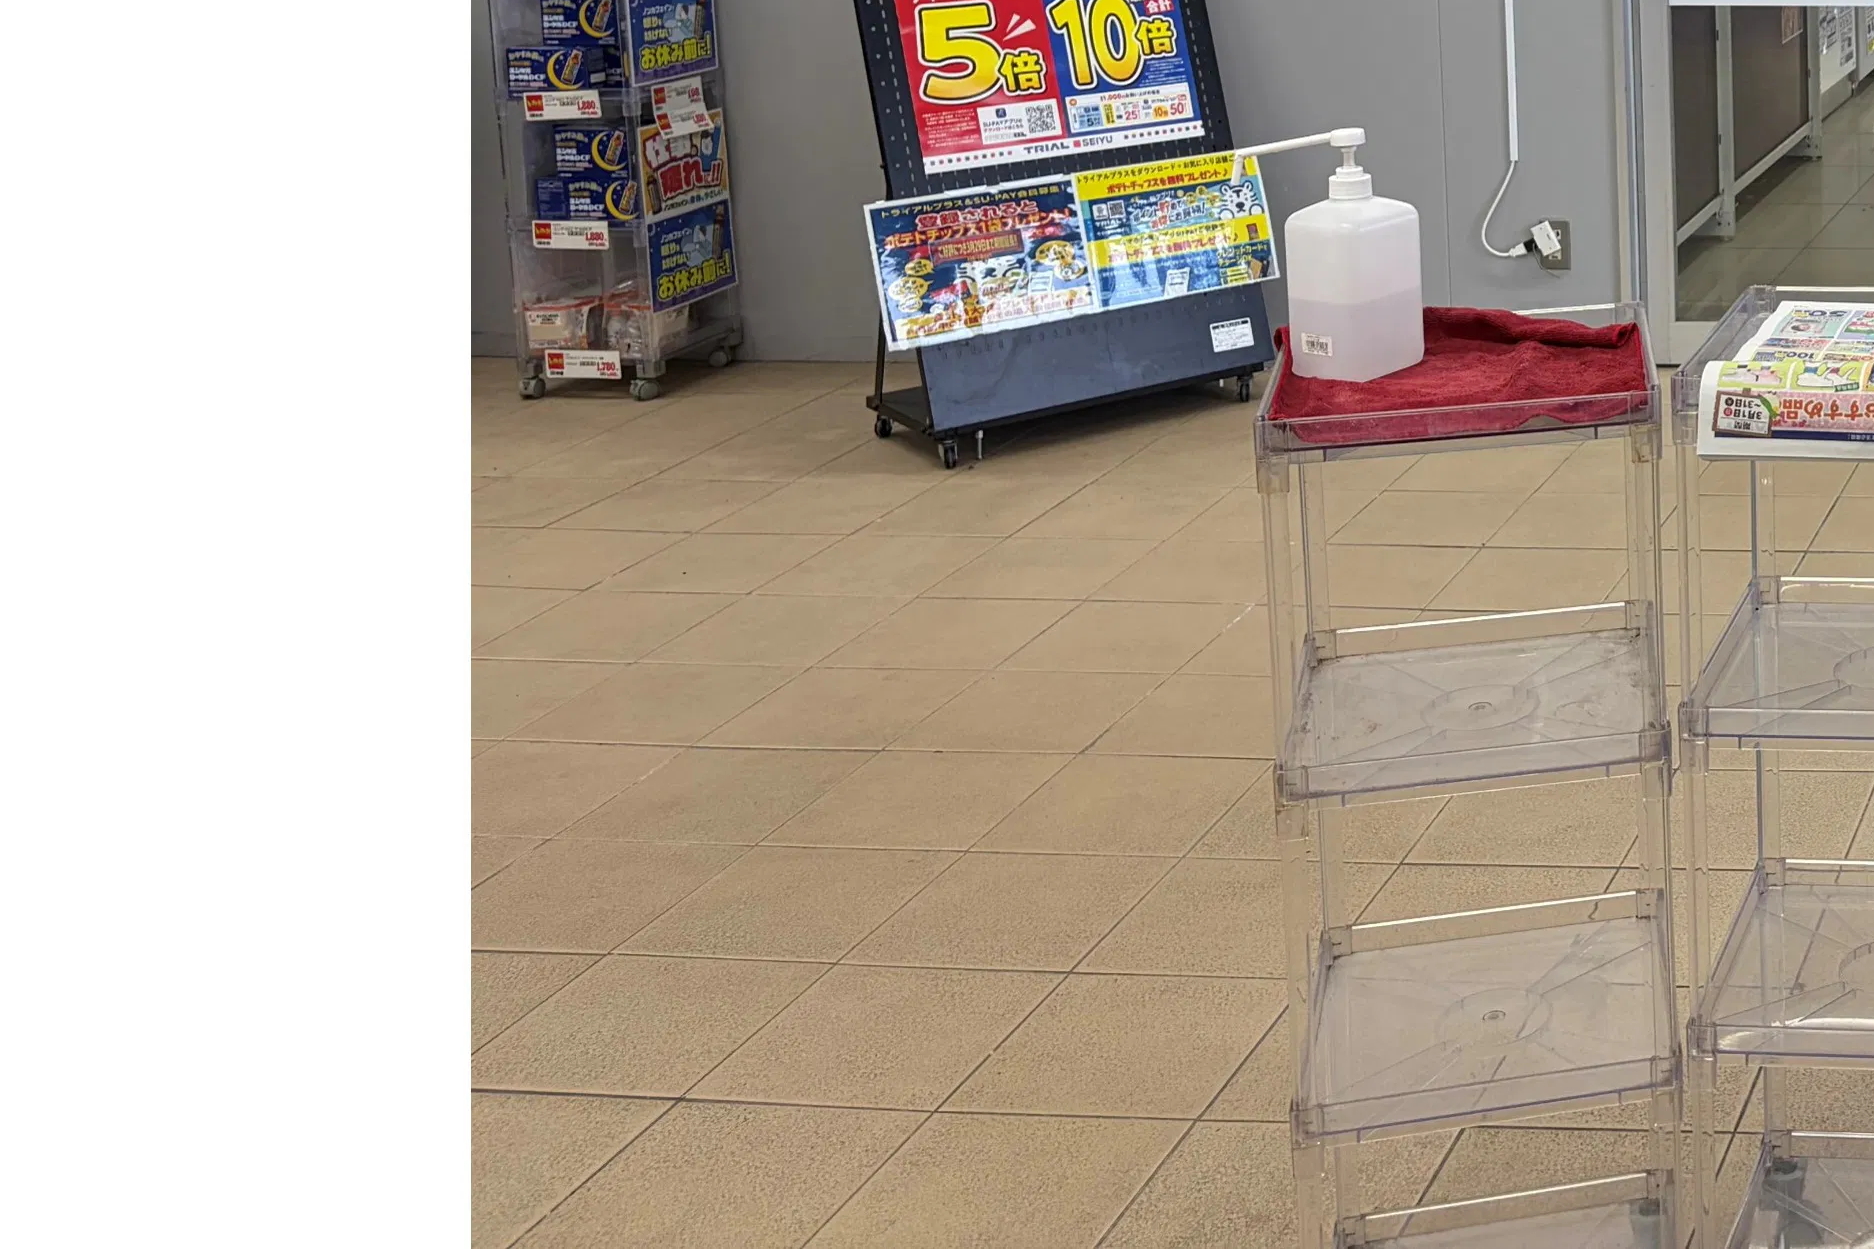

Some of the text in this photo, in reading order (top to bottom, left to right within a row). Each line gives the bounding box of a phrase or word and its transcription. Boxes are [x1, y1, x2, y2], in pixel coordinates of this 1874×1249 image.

[641, 34, 712, 70] お休み前に!
[919, 3, 1046, 99] 5倍
[1023, 135, 1113, 155] TRIAL SEIYU
[915, 200, 1039, 230] 登録されると
[658, 250, 732, 299] お休み前に!
[1733, 421, 1752, 431] 期間
